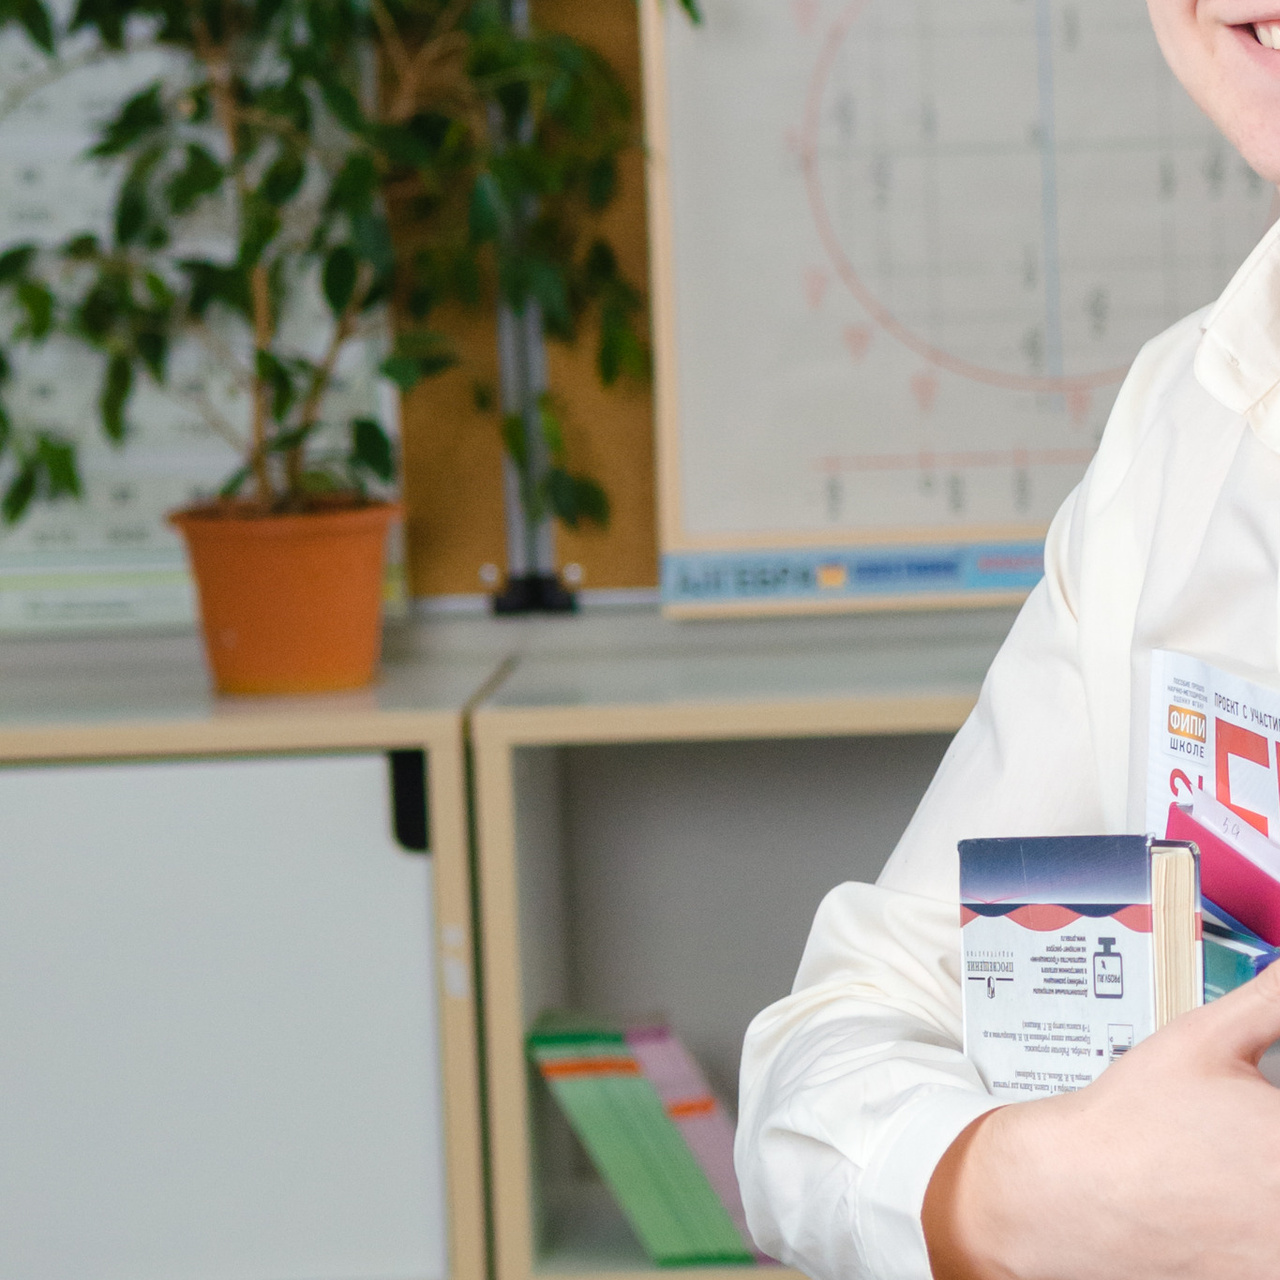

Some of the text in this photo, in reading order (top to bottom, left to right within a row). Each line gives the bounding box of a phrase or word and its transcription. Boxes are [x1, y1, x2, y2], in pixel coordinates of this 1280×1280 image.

[1214, 692, 1239, 717] ПРОЕКТ
[1242, 704, 1248, 720] С
[1170, 710, 1205, 739] ФИПИ
[1170, 737, 1205, 759] ШКОЛЕ
[967, 960, 1014, 972] ПРОСВЕЩЕНИЕ
